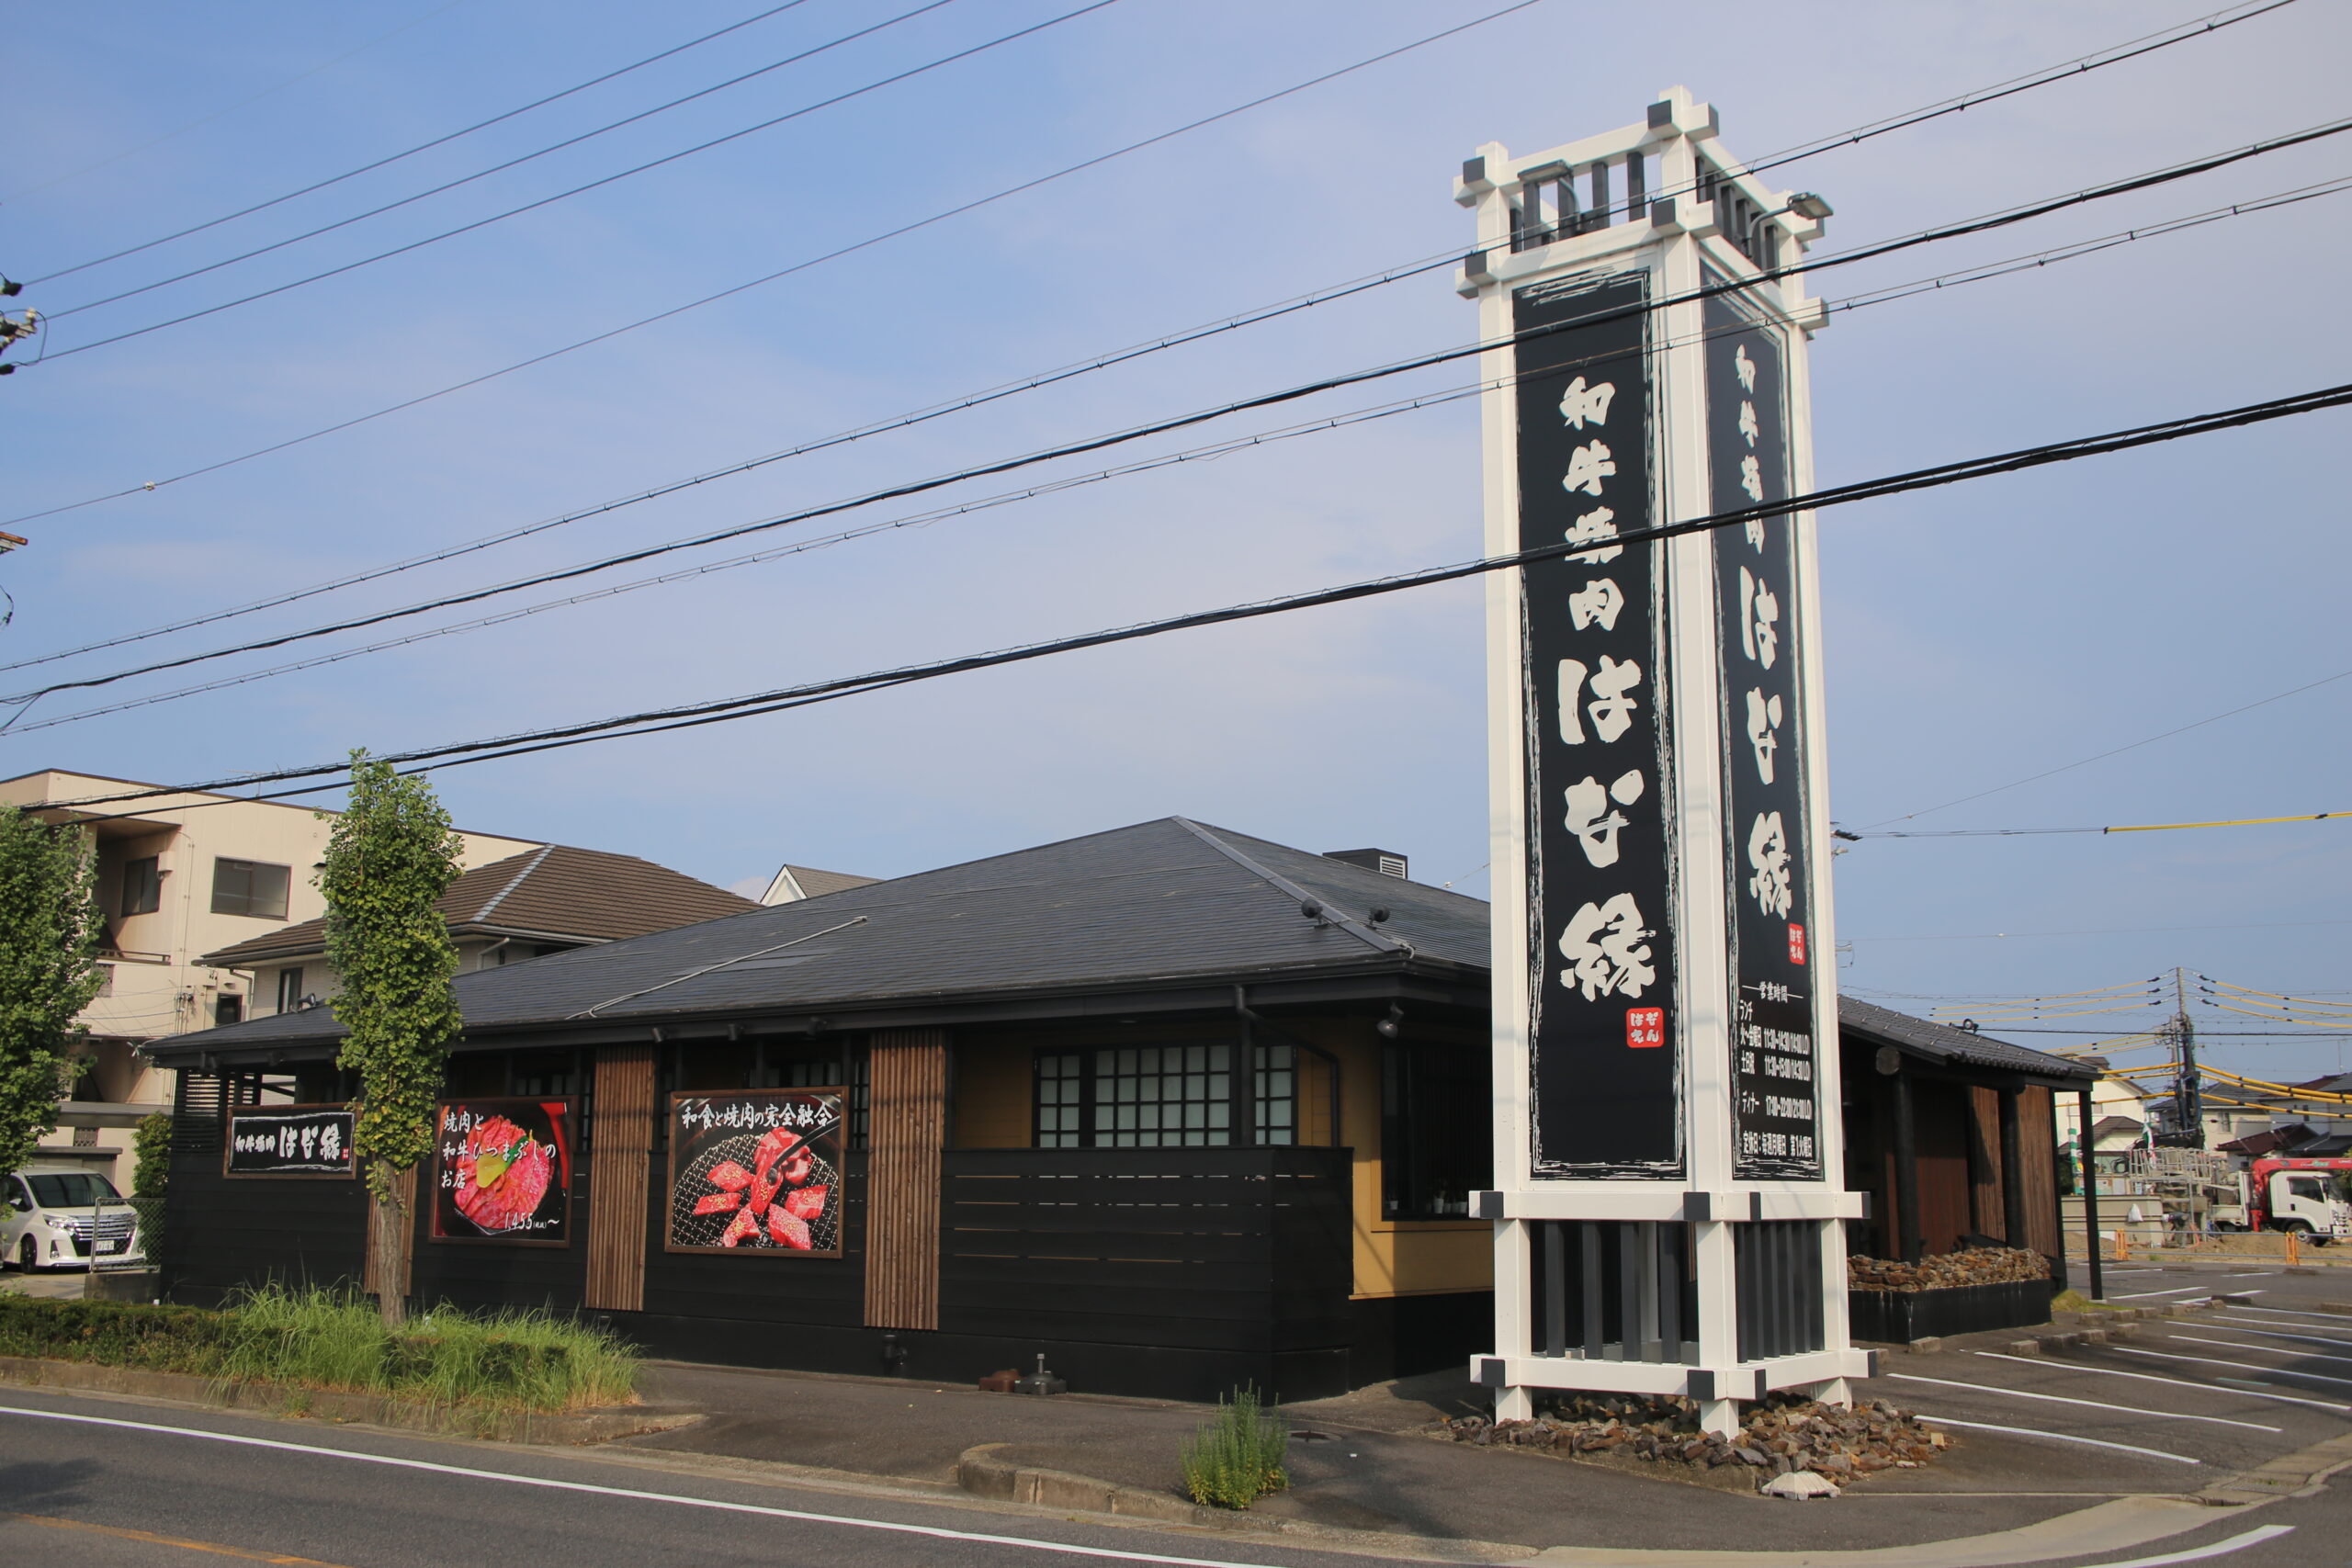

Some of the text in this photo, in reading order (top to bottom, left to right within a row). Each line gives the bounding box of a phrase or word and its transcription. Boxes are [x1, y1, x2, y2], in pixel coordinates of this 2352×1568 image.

[1759, 981, 1788, 1003] 営業時間
[1739, 999, 1753, 1021] ランチ
[443, 1111, 484, 1134] 焼肉と
[681, 1101, 832, 1130] 和食と焼肉の完全融合
[442, 1139, 557, 1162] 和牛ひつまぶしの
[441, 1168, 467, 1190] お店
